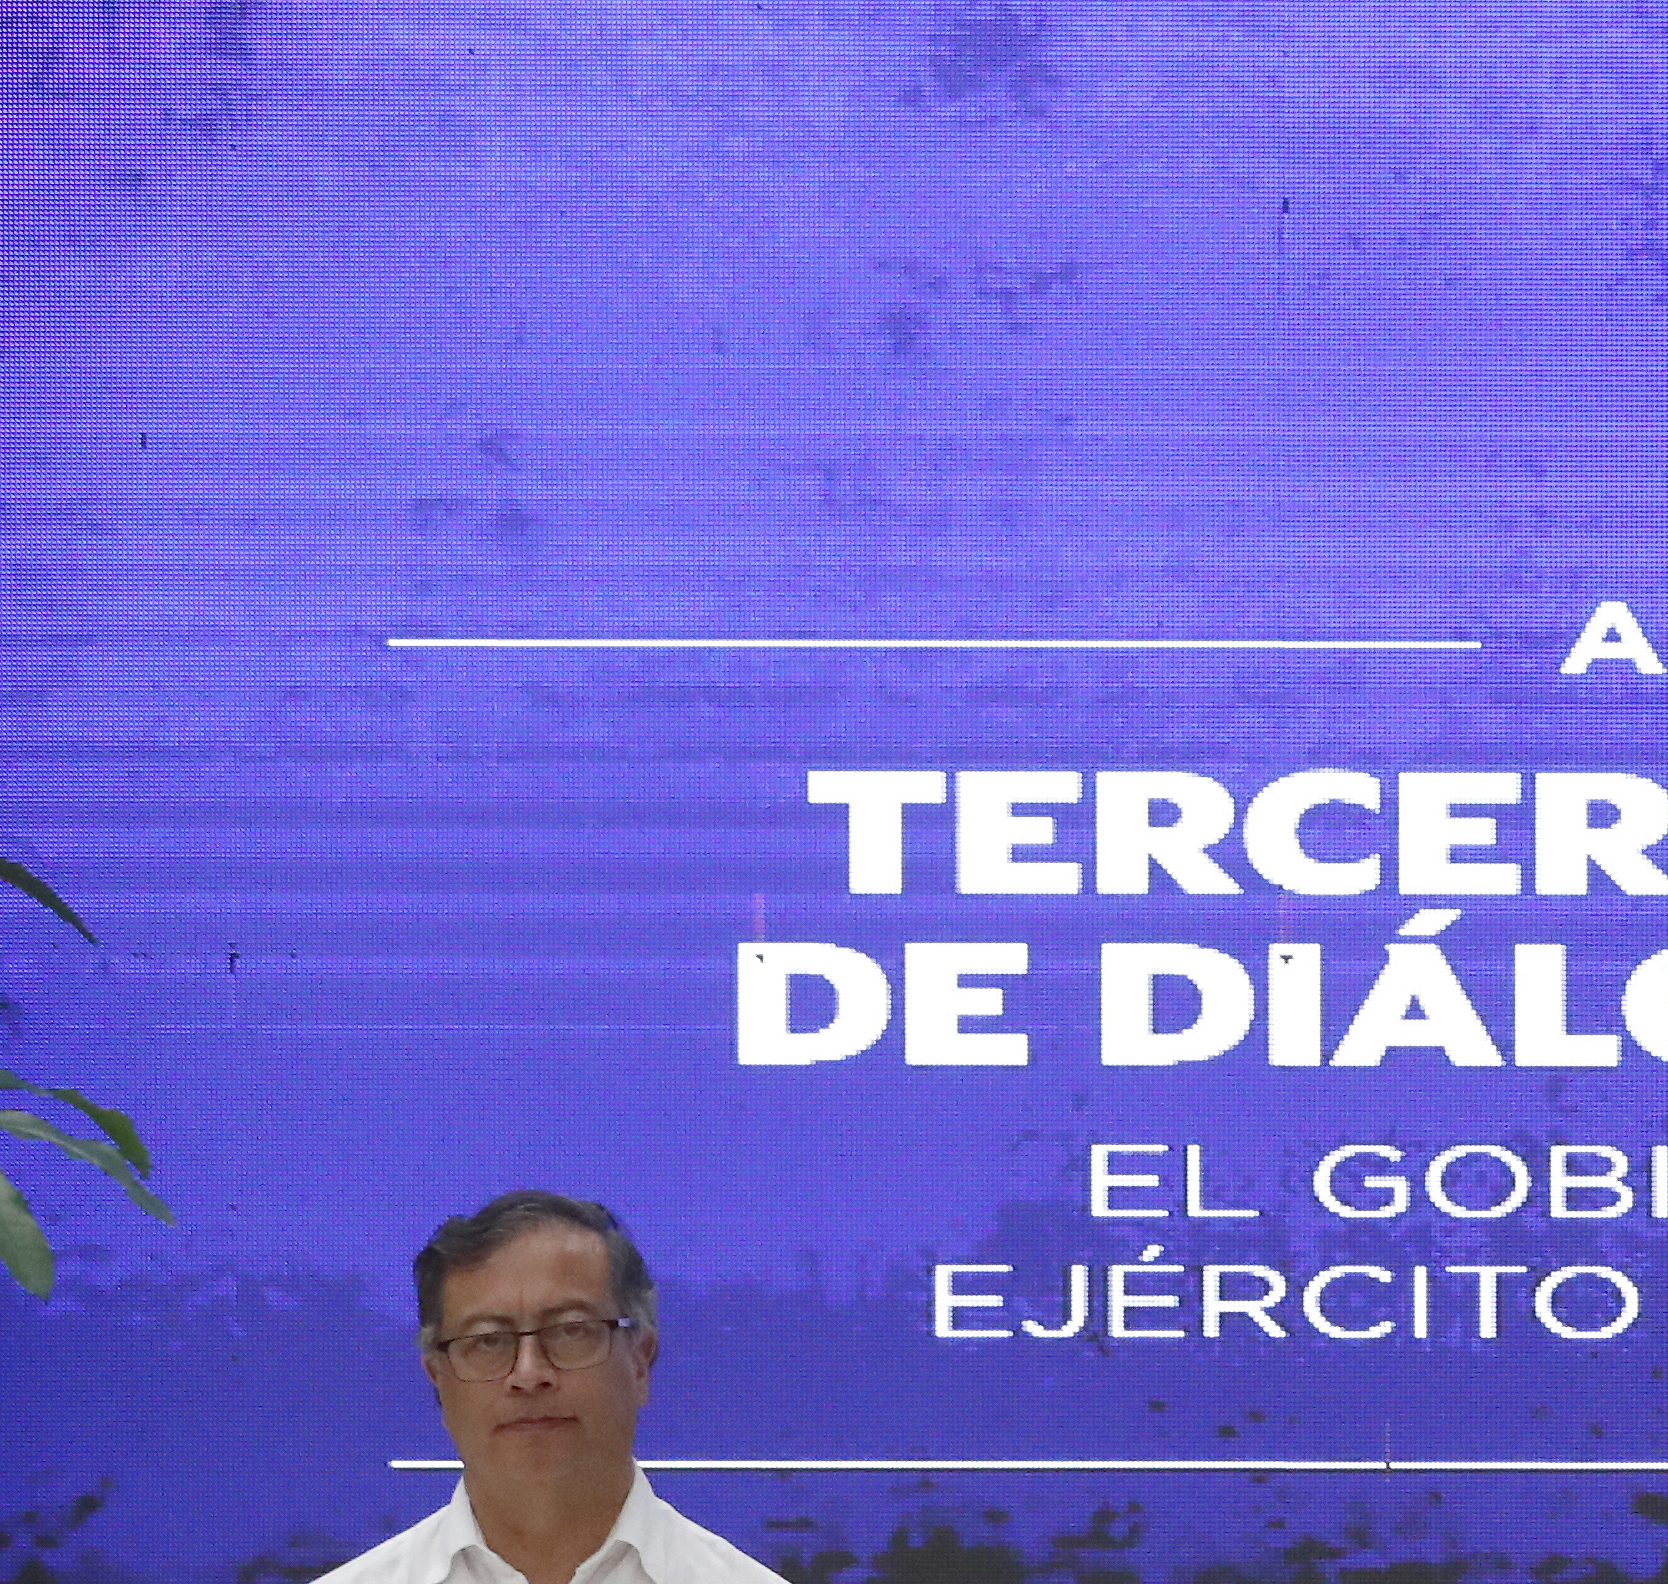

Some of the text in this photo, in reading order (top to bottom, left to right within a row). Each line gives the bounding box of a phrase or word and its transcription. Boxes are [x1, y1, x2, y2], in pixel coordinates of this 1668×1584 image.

[734, 940, 1030, 1067] DE
[1089, 1142, 1260, 1218] EL
[930, 1244, 1641, 1340] EJÉRCITO
